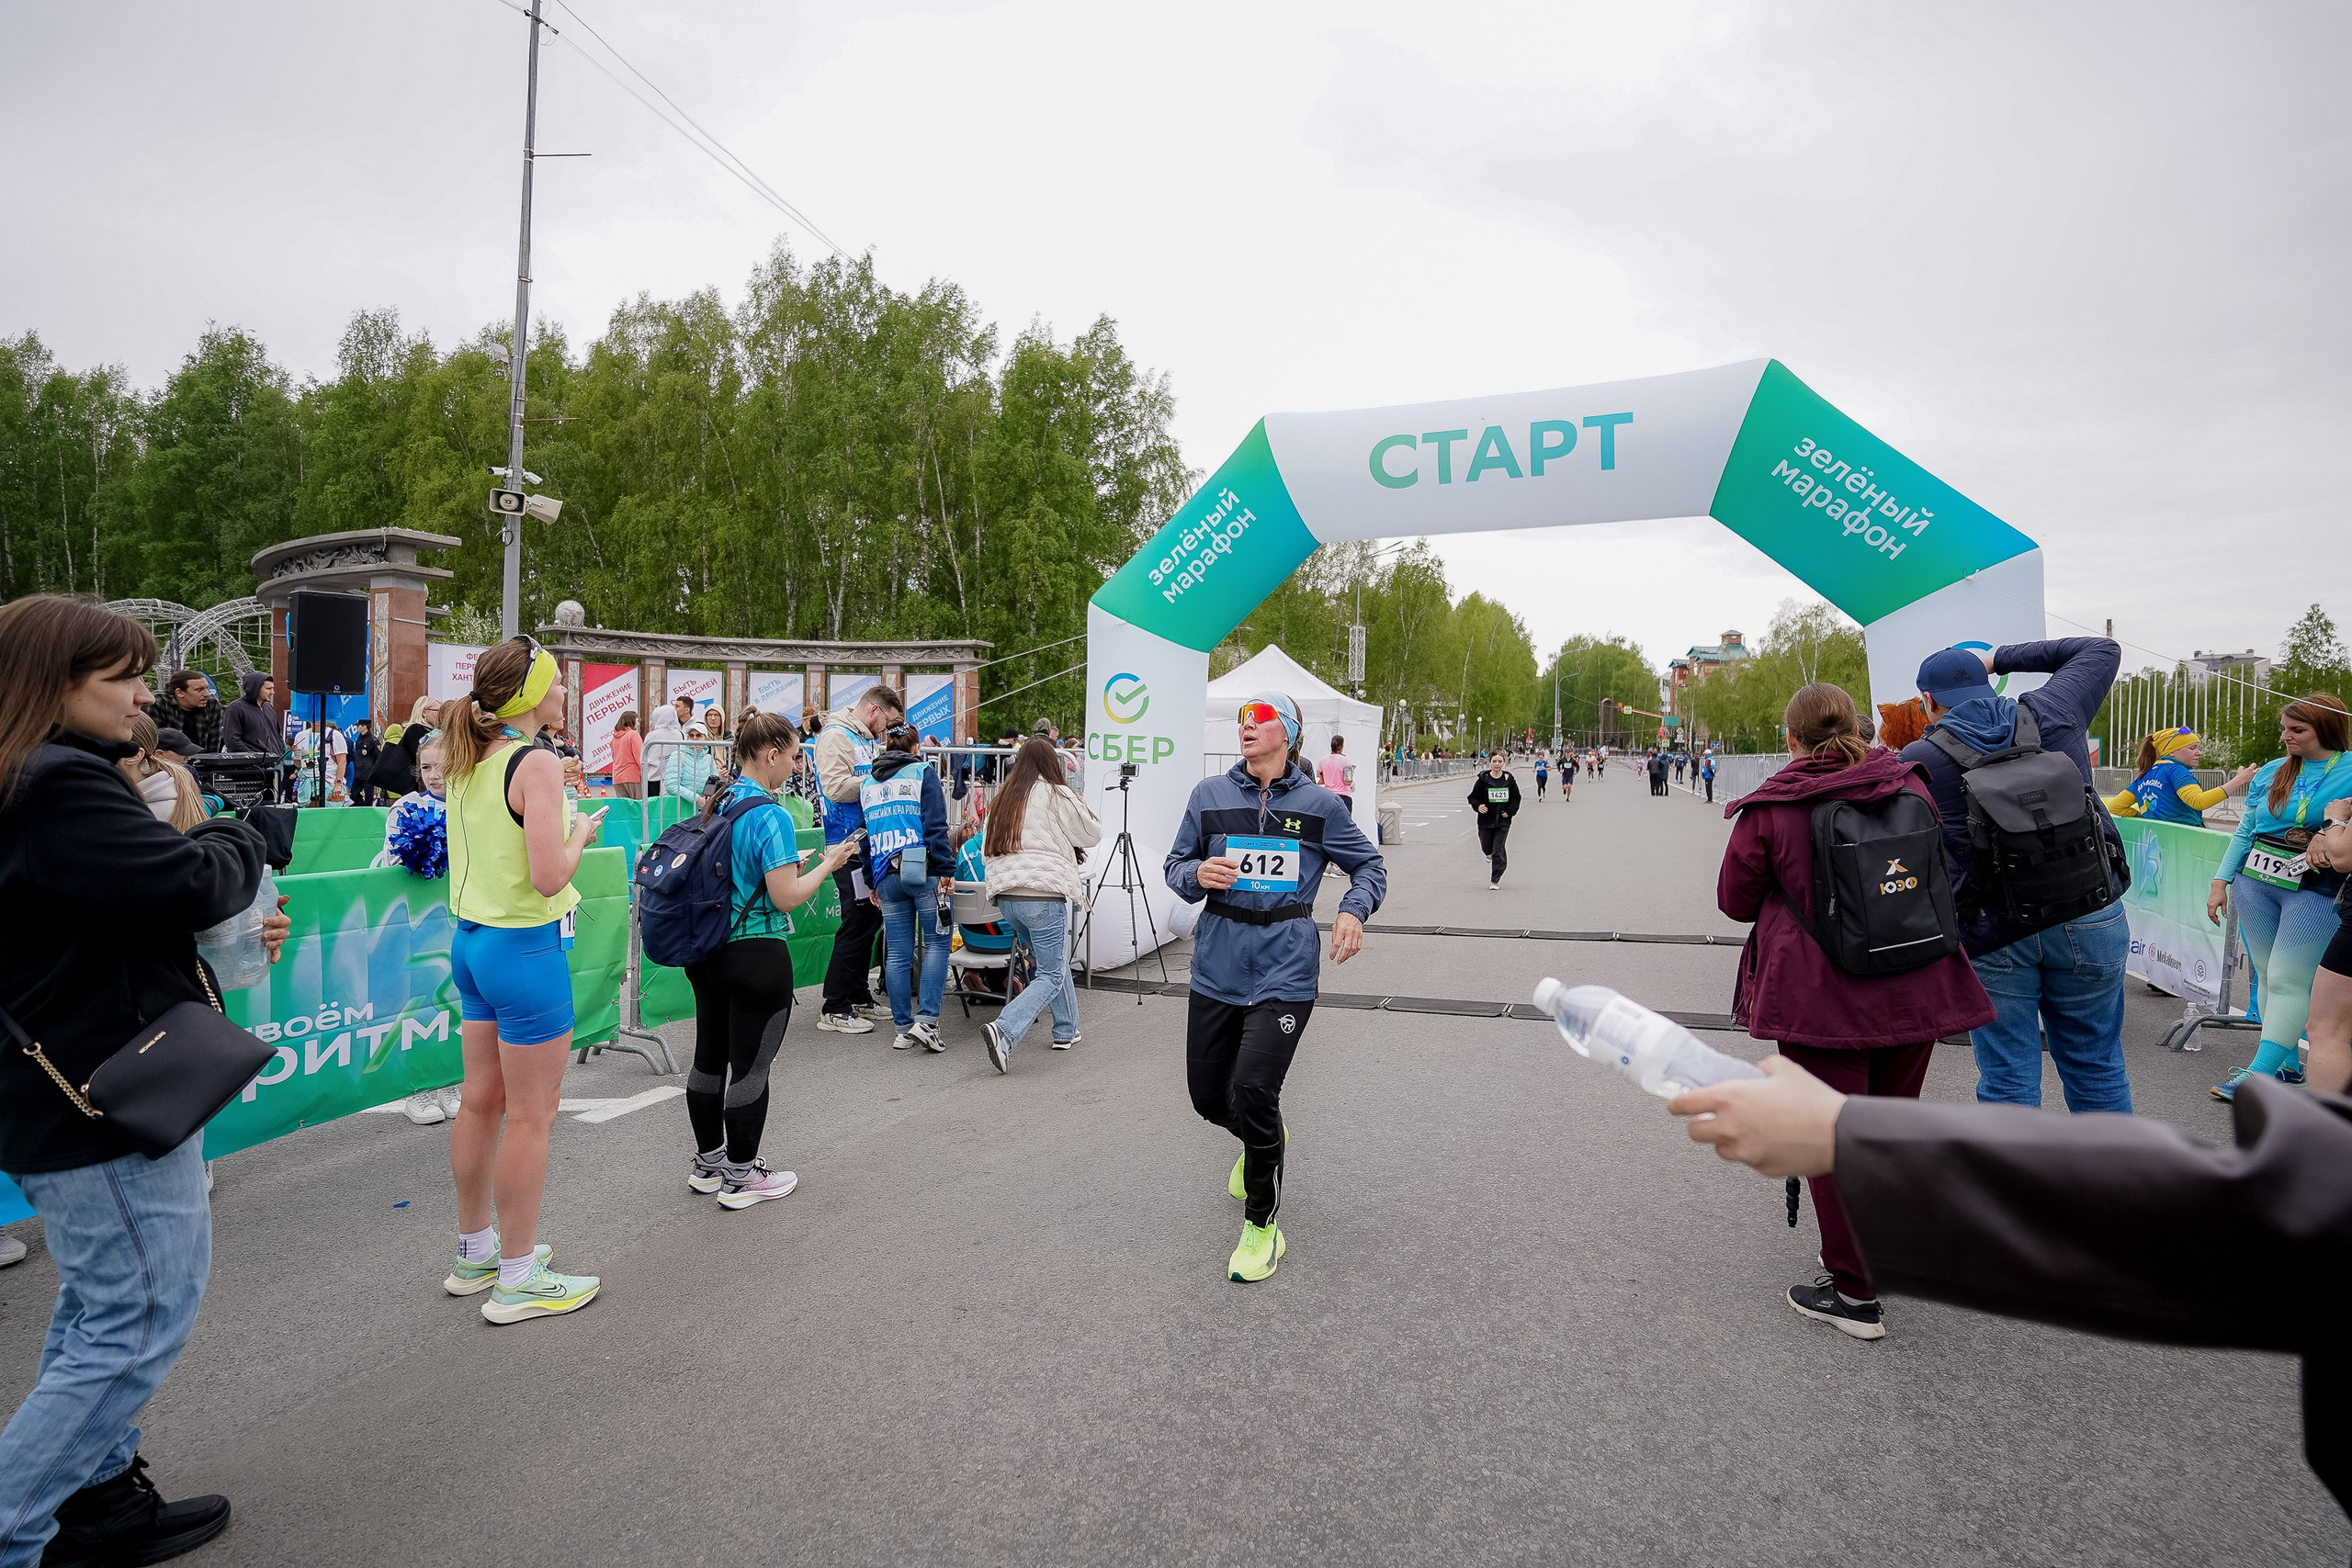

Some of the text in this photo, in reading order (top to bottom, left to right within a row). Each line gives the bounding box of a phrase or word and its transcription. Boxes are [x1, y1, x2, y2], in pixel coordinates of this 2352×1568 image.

[1369, 412, 1634, 489] СТАРТ
[1793, 437, 1935, 536] зелёный
[1770, 459, 1907, 560] марафон
[1148, 488, 1240, 586] зелёный
[1162, 508, 1257, 604] марафон
[589, 682, 633, 711] ДВИЖЕНИЕ
[673, 680, 696, 694] БЫТЬ
[684, 678, 718, 698] ОССИЕЙ
[758, 680, 781, 694] БЫТЬ
[762, 678, 799, 701] ДВИЖЕНИИ
[851, 680, 877, 697] ВМЕСТЕ
[586, 694, 635, 725] ПЕРВЫХ
[911, 694, 950, 722] ДВИЖЕНИЕ
[1088, 732, 1174, 764] СБЕР
[870, 828, 919, 856] СУДЬЯ
[1239, 853, 1284, 876] 612
[2254, 853, 2292, 877] 119
[2130, 938, 2146, 956] air
[242, 1010, 463, 1103] ритм
